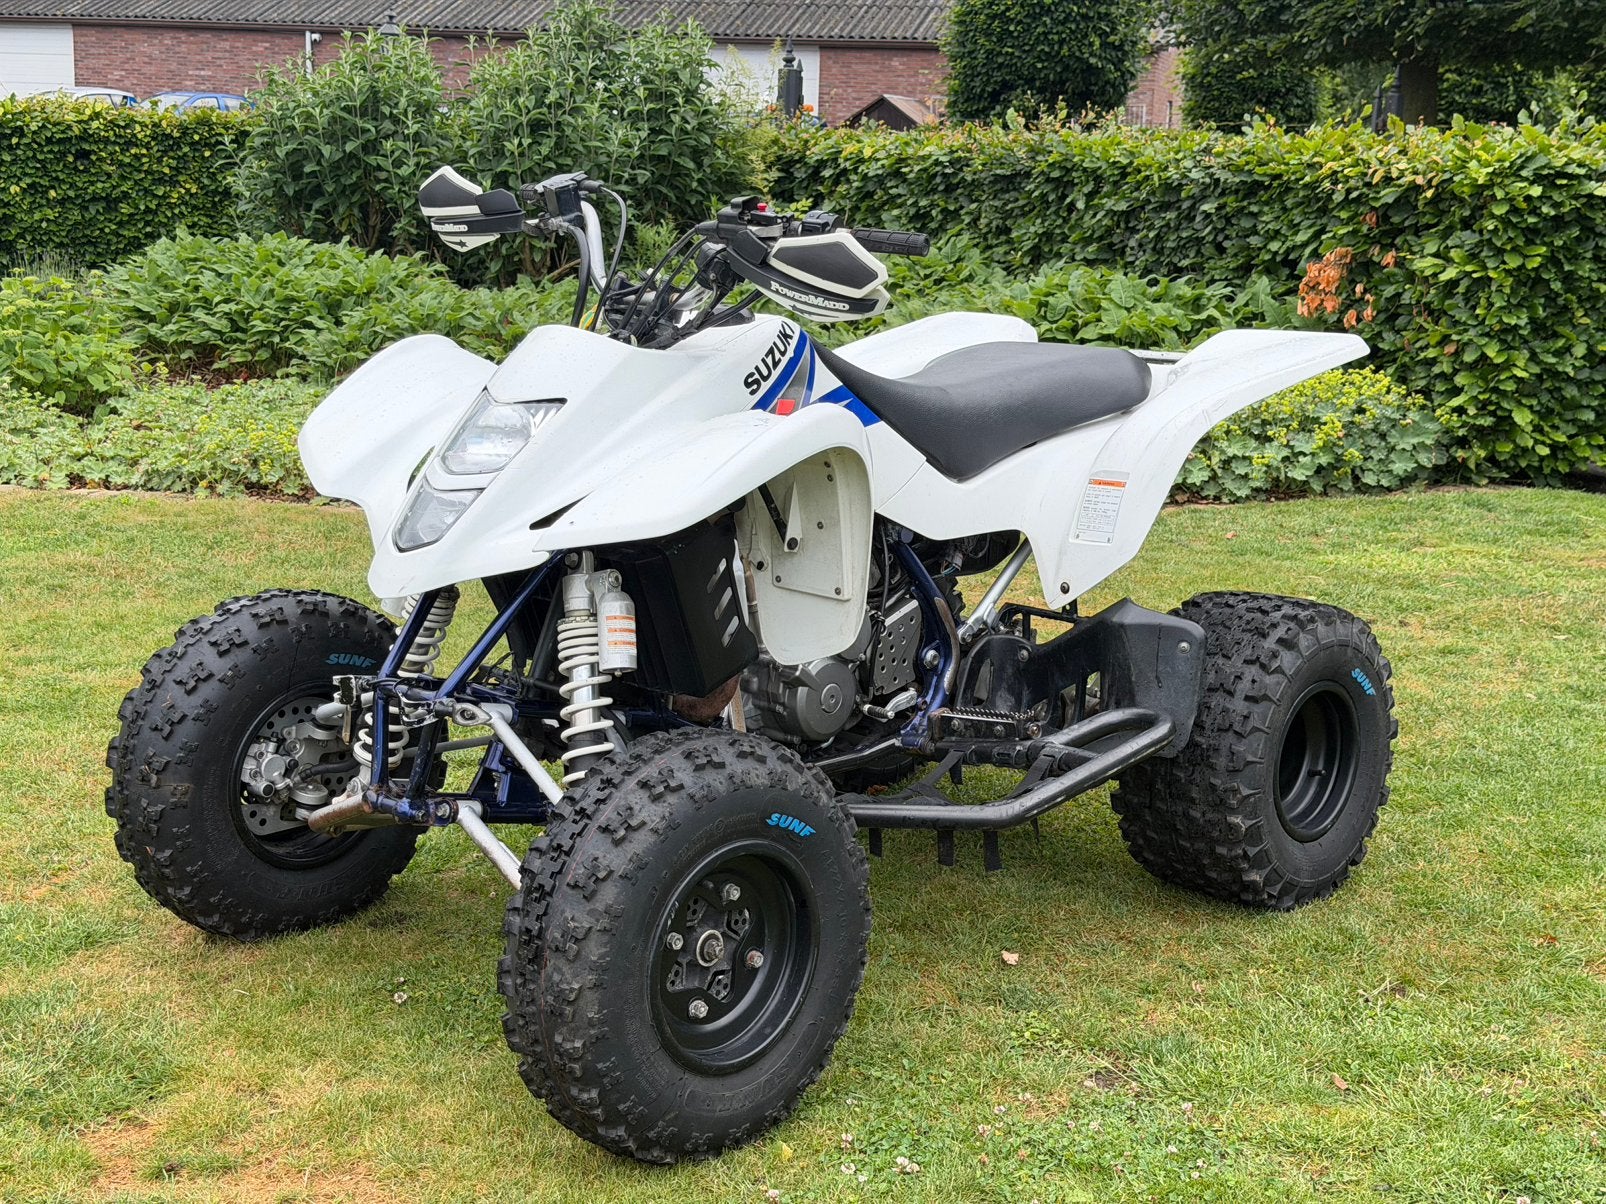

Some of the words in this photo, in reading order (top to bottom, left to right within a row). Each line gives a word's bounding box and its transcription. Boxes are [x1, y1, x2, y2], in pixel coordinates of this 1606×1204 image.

[743, 320, 795, 397] SUZUKI
[325, 653, 377, 668] SUNF
[1351, 667, 1377, 696] SUNF
[765, 812, 817, 837] SUNF
